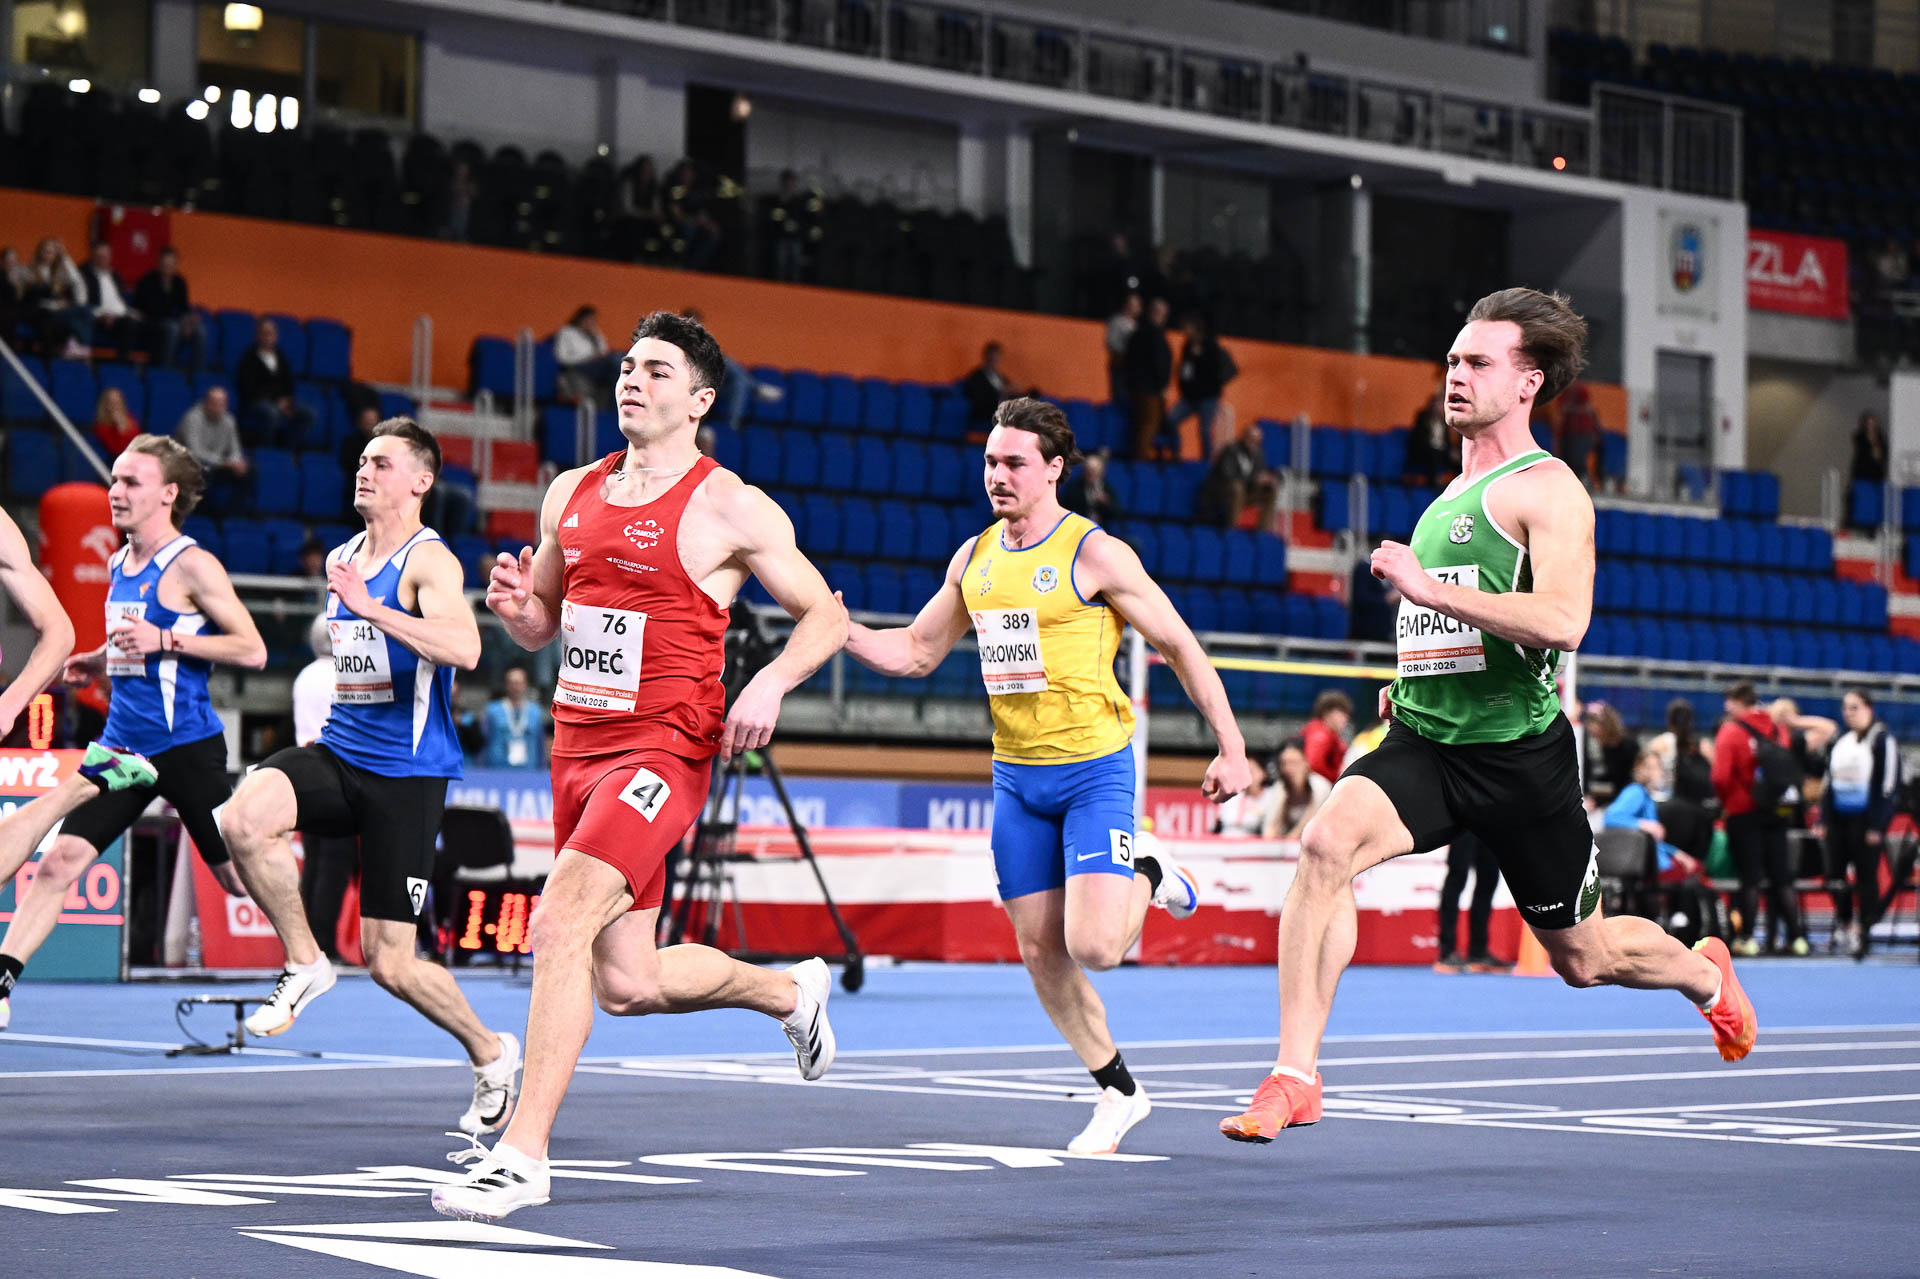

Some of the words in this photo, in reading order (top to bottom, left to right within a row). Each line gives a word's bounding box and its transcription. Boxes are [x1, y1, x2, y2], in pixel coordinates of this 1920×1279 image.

[602, 613, 627, 635] 76
[1002, 613, 1030, 630] 389
[353, 625, 376, 640] 341
[1402, 661, 1432, 673] TORUŃ
[1433, 660, 1457, 671] 2026
[565, 693, 588, 705] TORUŃ
[588, 697, 609, 708] 2026
[632, 782, 664, 811] 4
[1119, 834, 1131, 861] 5
[411, 883, 423, 909] 6
